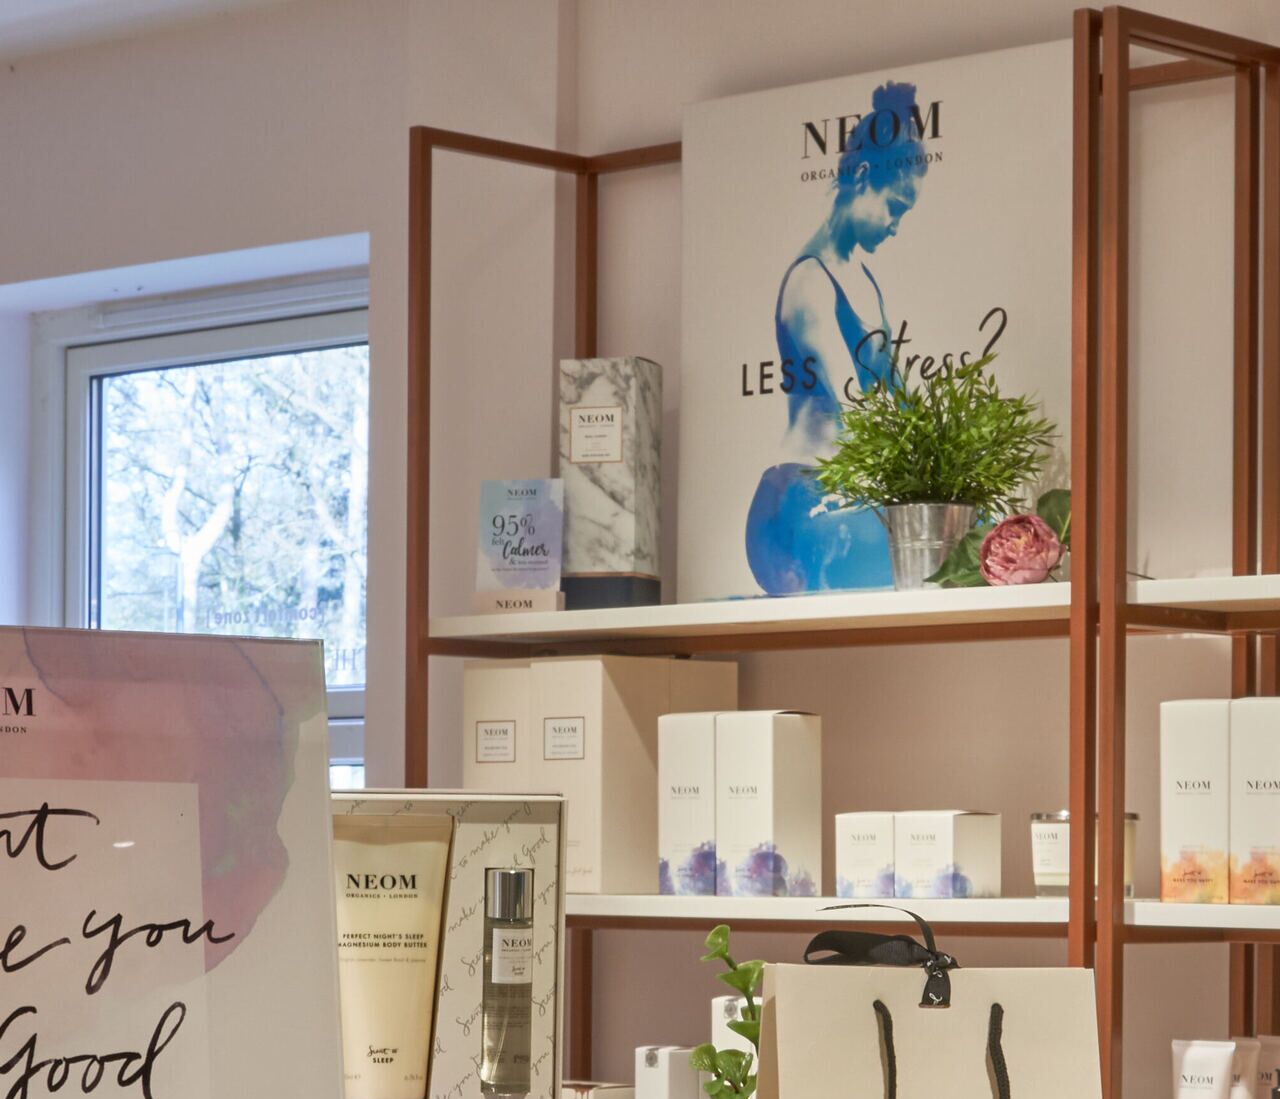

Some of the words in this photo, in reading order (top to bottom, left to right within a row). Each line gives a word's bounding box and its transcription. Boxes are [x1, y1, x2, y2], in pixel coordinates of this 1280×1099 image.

[801, 101, 943, 159] NEOM
[742, 356, 817, 396] LESS
[845, 307, 1008, 402] Stress?
[492, 513, 536, 538] 95%
[502, 537, 550, 560] Calmer
[346, 874, 417, 890] NEOM
[82, 910, 235, 995] you
